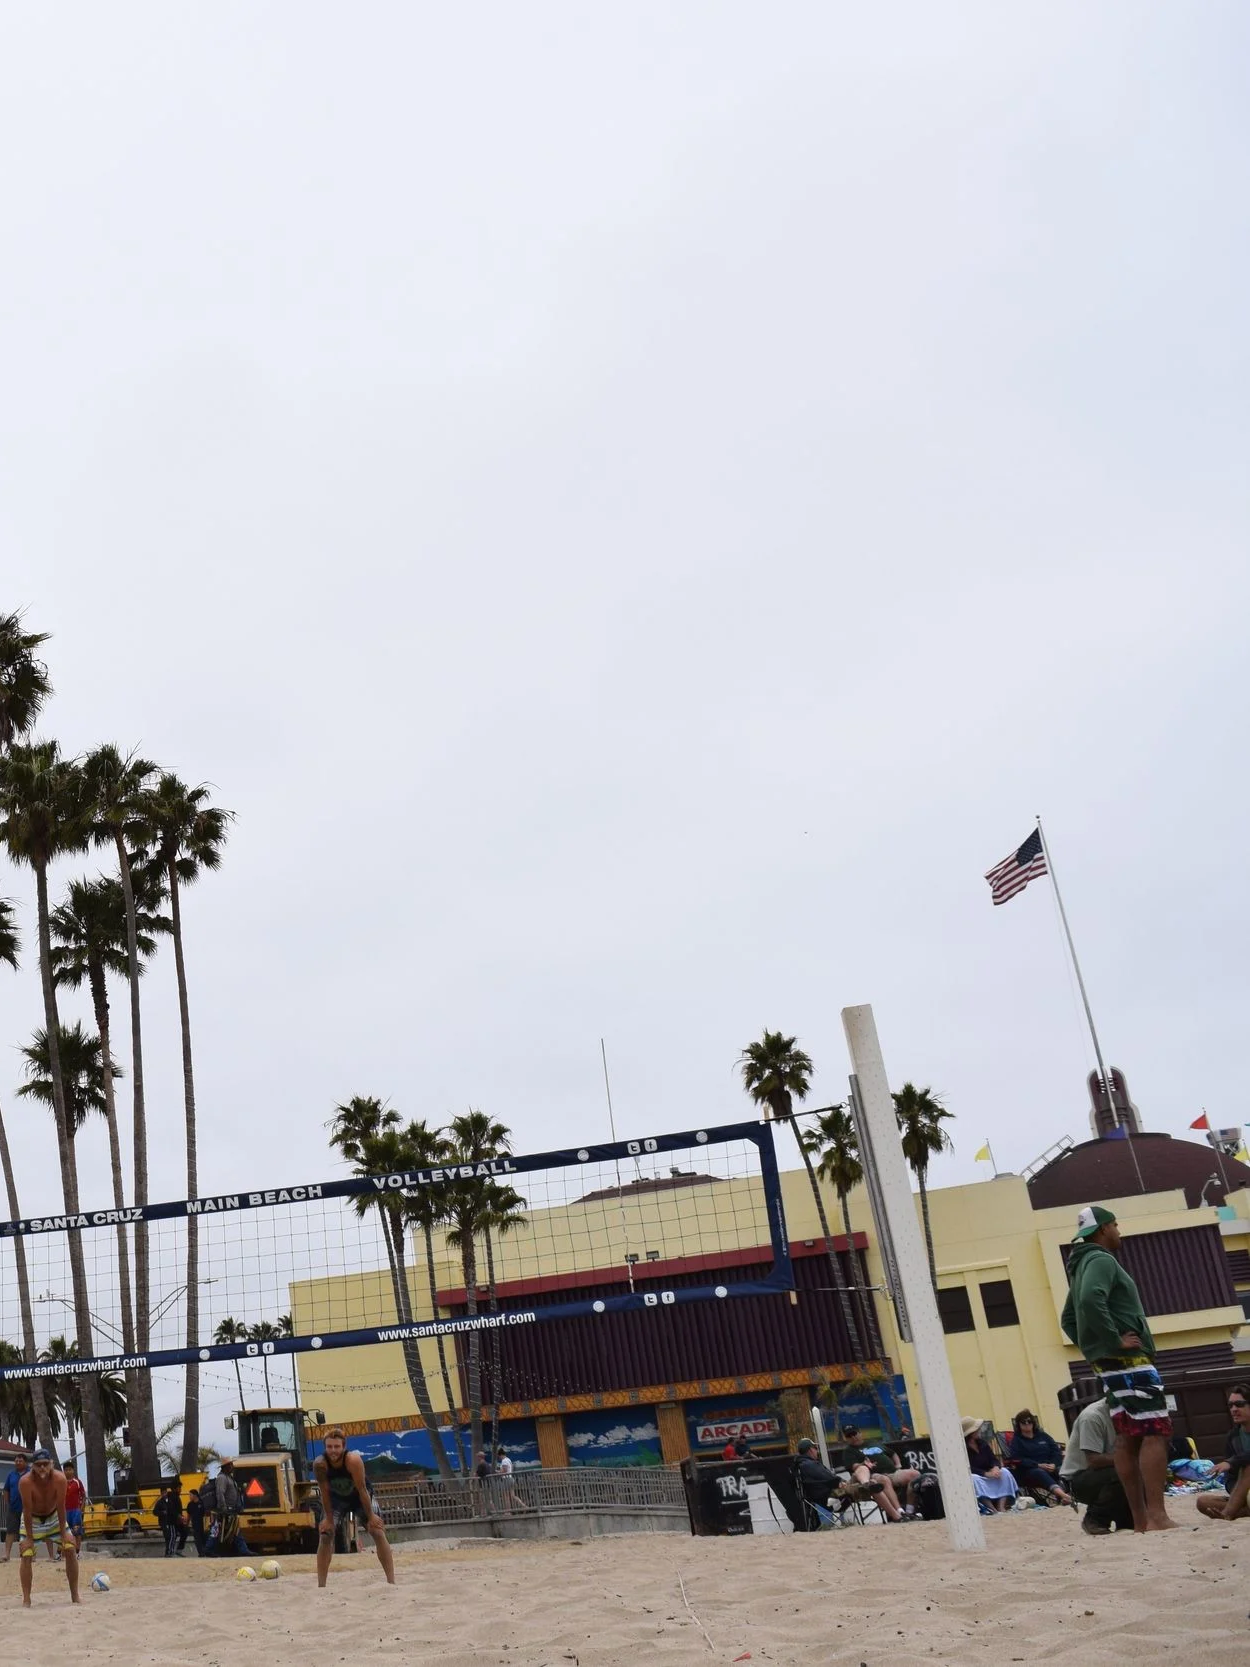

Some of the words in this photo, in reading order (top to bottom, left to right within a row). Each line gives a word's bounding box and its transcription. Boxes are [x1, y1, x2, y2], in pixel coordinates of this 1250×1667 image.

[186, 1196, 240, 1214] MAIN
[248, 1185, 323, 1206] BEACH
[372, 1160, 518, 1191] VOLLEYBALL
[29, 1215, 88, 1233] SANTA
[93, 1208, 144, 1225] CRUZ
[377, 1311, 536, 1342] www.santacruzwharf.com
[4, 1357, 147, 1380] www.santacruzwharf.com
[701, 1420, 776, 1440] ARCADE
